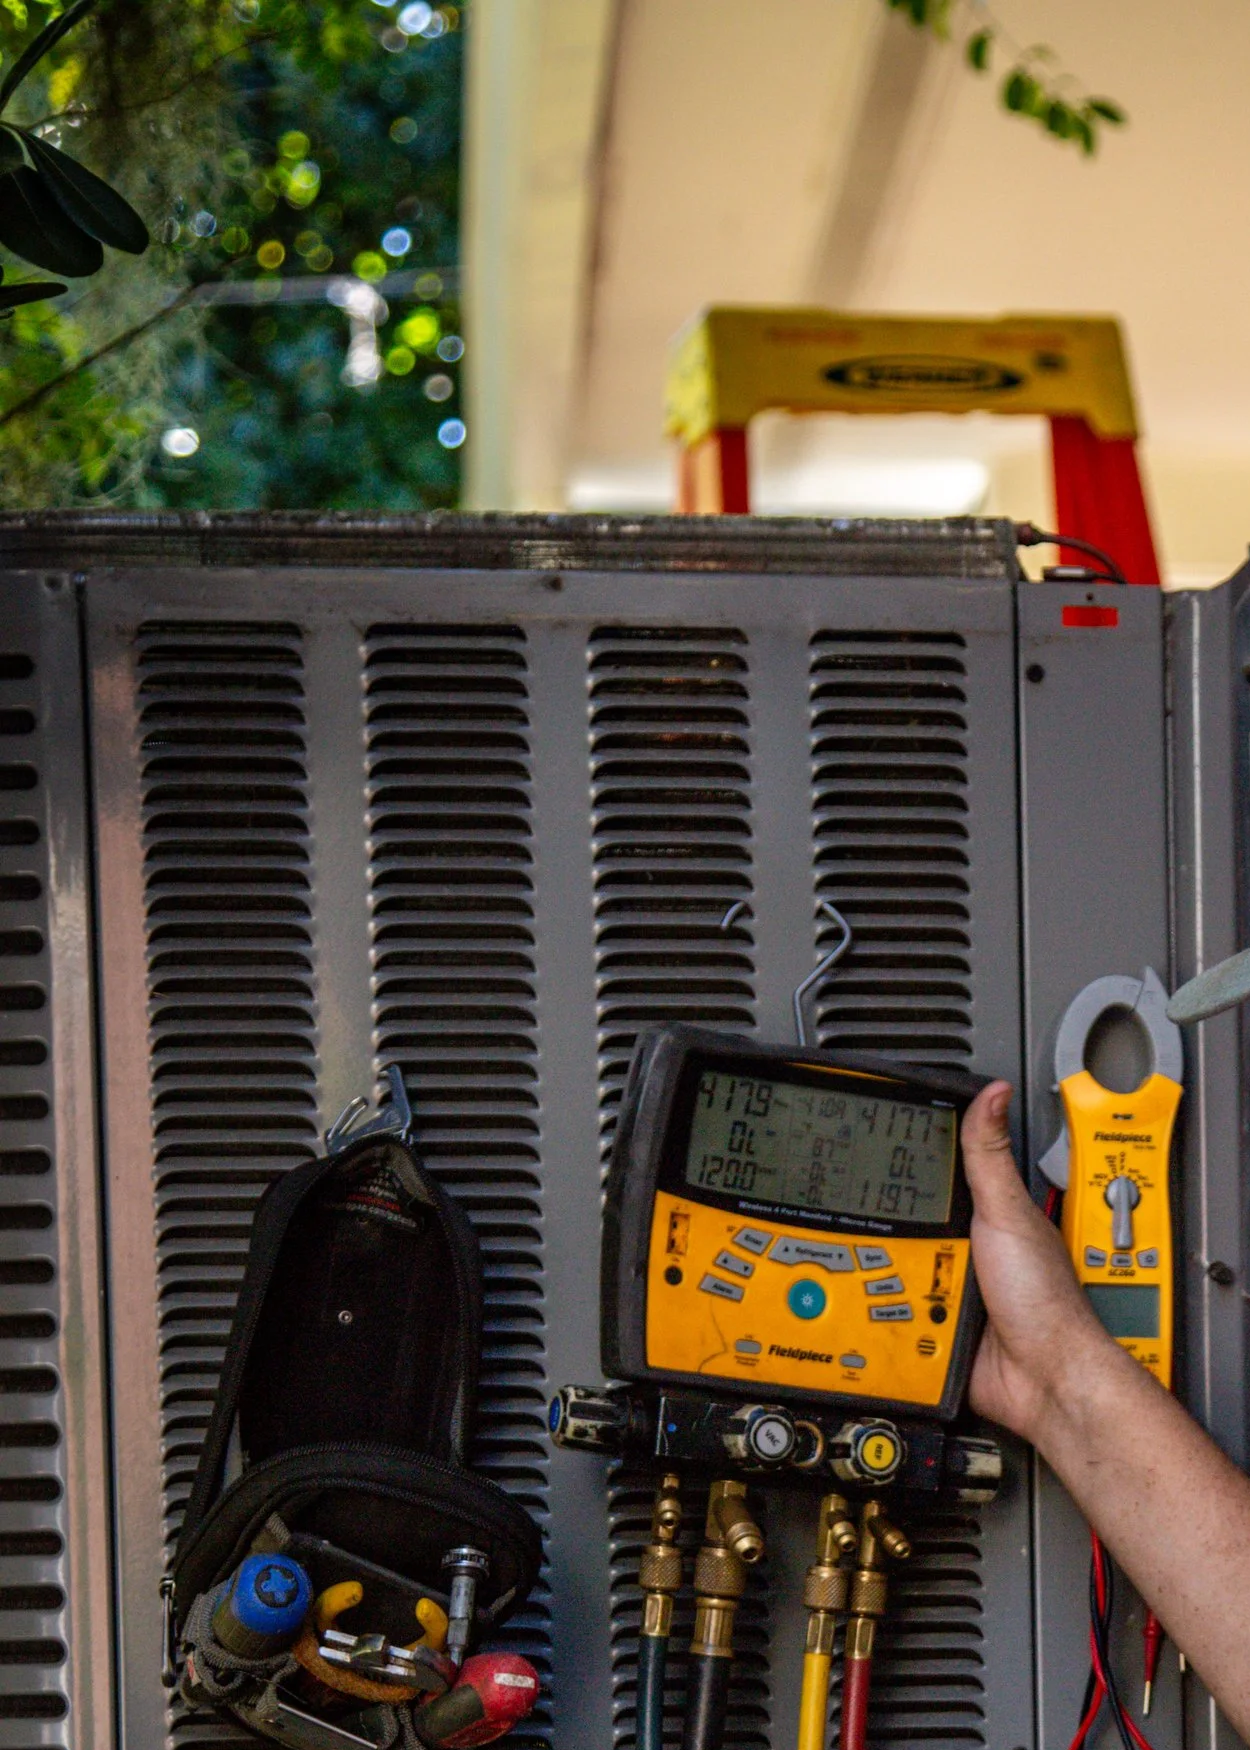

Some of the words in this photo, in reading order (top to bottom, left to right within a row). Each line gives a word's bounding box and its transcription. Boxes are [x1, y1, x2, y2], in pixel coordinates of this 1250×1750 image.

[1094, 1130, 1153, 1144] Fieldpiece
[768, 1344, 834, 1364] Fieldpiece
[765, 1429, 781, 1447] VAC
